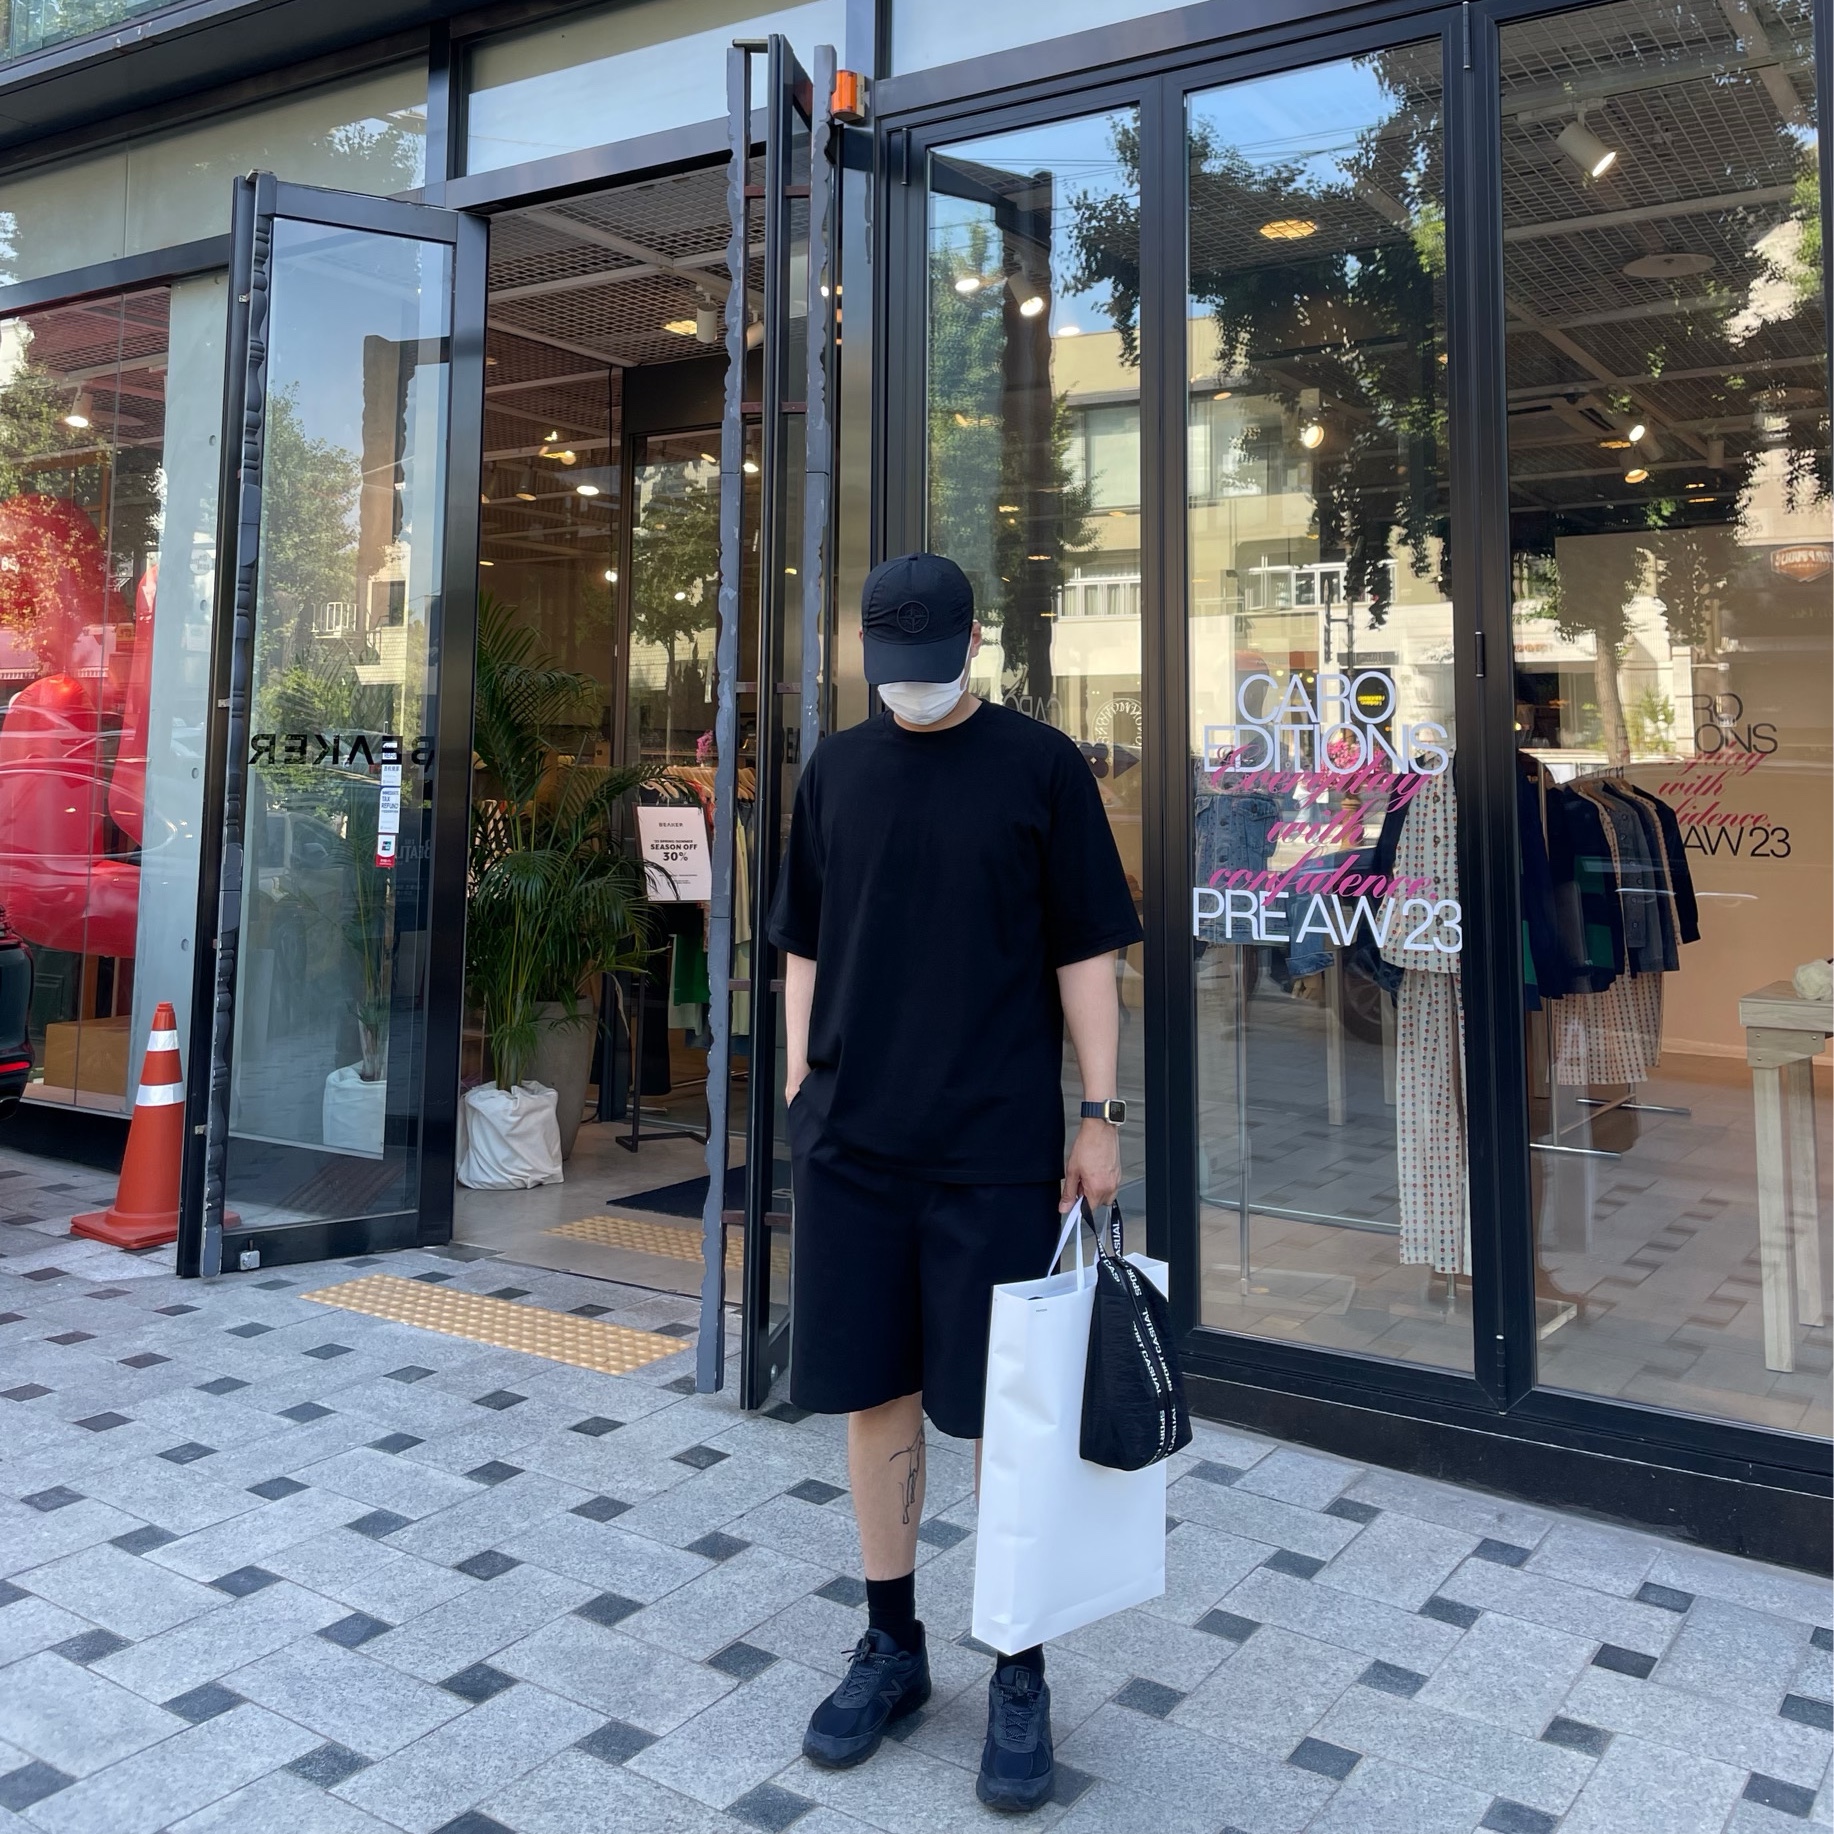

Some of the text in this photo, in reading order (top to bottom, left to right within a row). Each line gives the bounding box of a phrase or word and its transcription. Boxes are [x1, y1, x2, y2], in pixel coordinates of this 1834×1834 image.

[1237, 671, 1396, 725] CARO
[1204, 723, 1449, 775] EDITIONS
[1658, 768, 1734, 796] with
[1266, 799, 1386, 844] with
[1749, 826, 1791, 858] 23
[663, 852, 688, 861] 30%
[1209, 846, 1438, 907] confidence.
[1193, 887, 1462, 953] PRE AW 23
[1141, 1350, 1162, 1398] CASUAL
[1142, 1307, 1173, 1392] SPORT CASUAL
